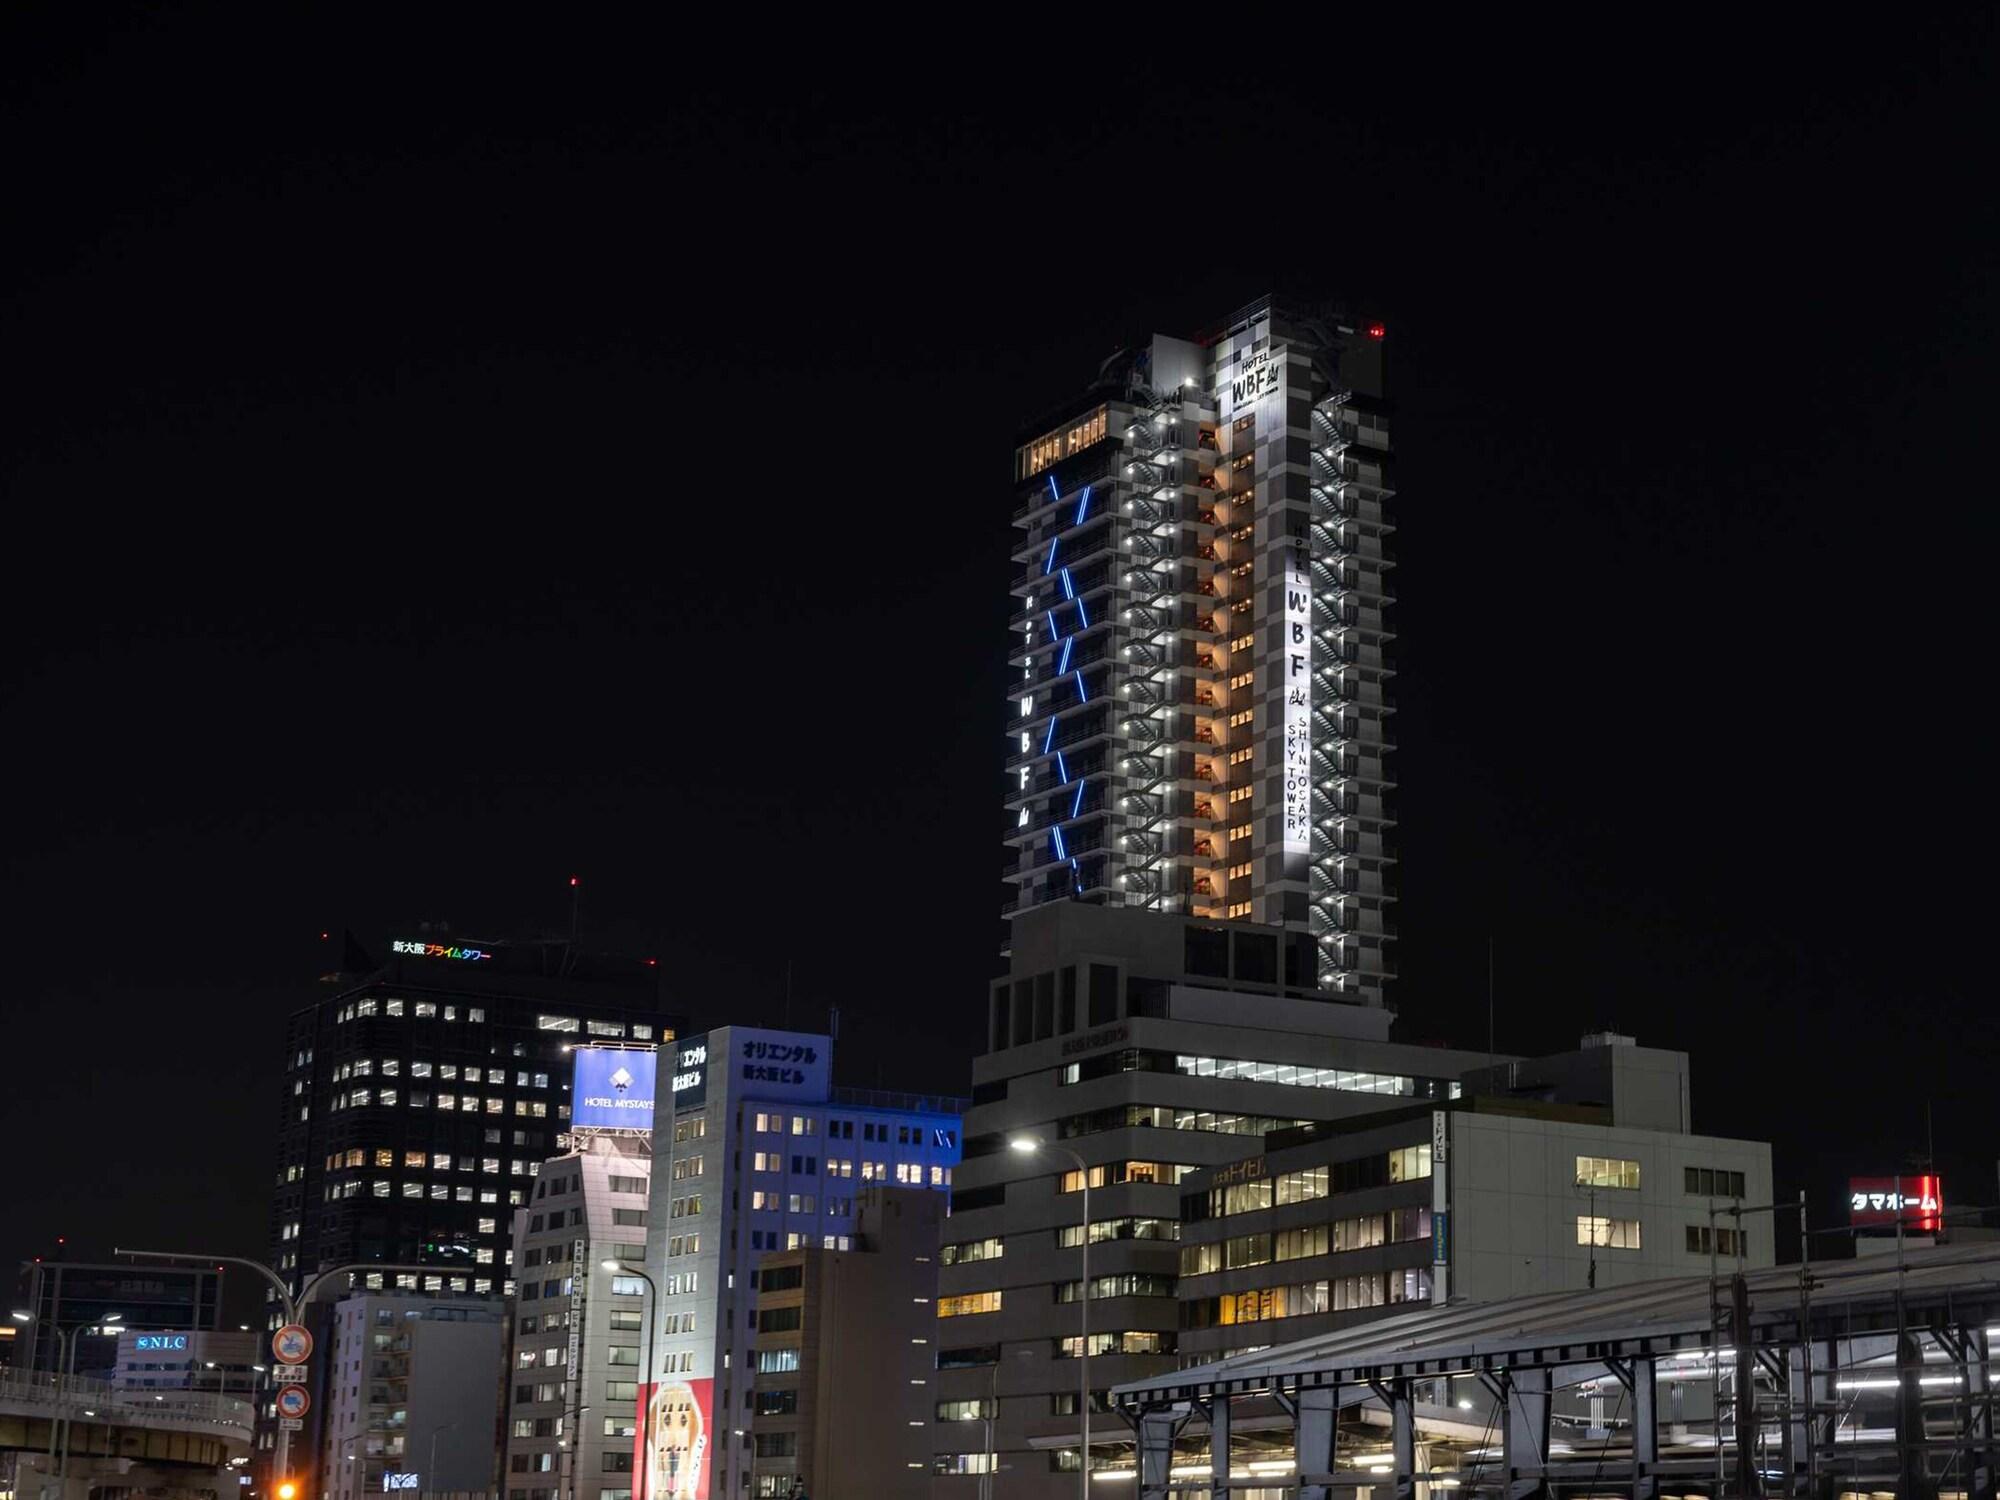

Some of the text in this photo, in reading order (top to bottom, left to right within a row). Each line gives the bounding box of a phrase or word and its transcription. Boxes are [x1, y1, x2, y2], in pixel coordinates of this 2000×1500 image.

[1241, 352, 1270, 375] HOTEL
[1232, 367, 1266, 403] WBF
[1295, 527, 1303, 584] HOTEL
[1288, 590, 1307, 677] WBF
[1020, 596, 1033, 790] HOTEL WBF
[1287, 725, 1297, 829] SKY TOWER
[393, 940, 491, 960] 新大阪プライムタワー
[743, 1041, 817, 1065] オリエンタル
[743, 1064, 804, 1084] 新大阪ビル
[584, 1097, 655, 1110] HOTEL MYSTAYS
[1851, 1192, 1938, 1210] タマホーム
[150, 1336, 184, 1348] NLC
